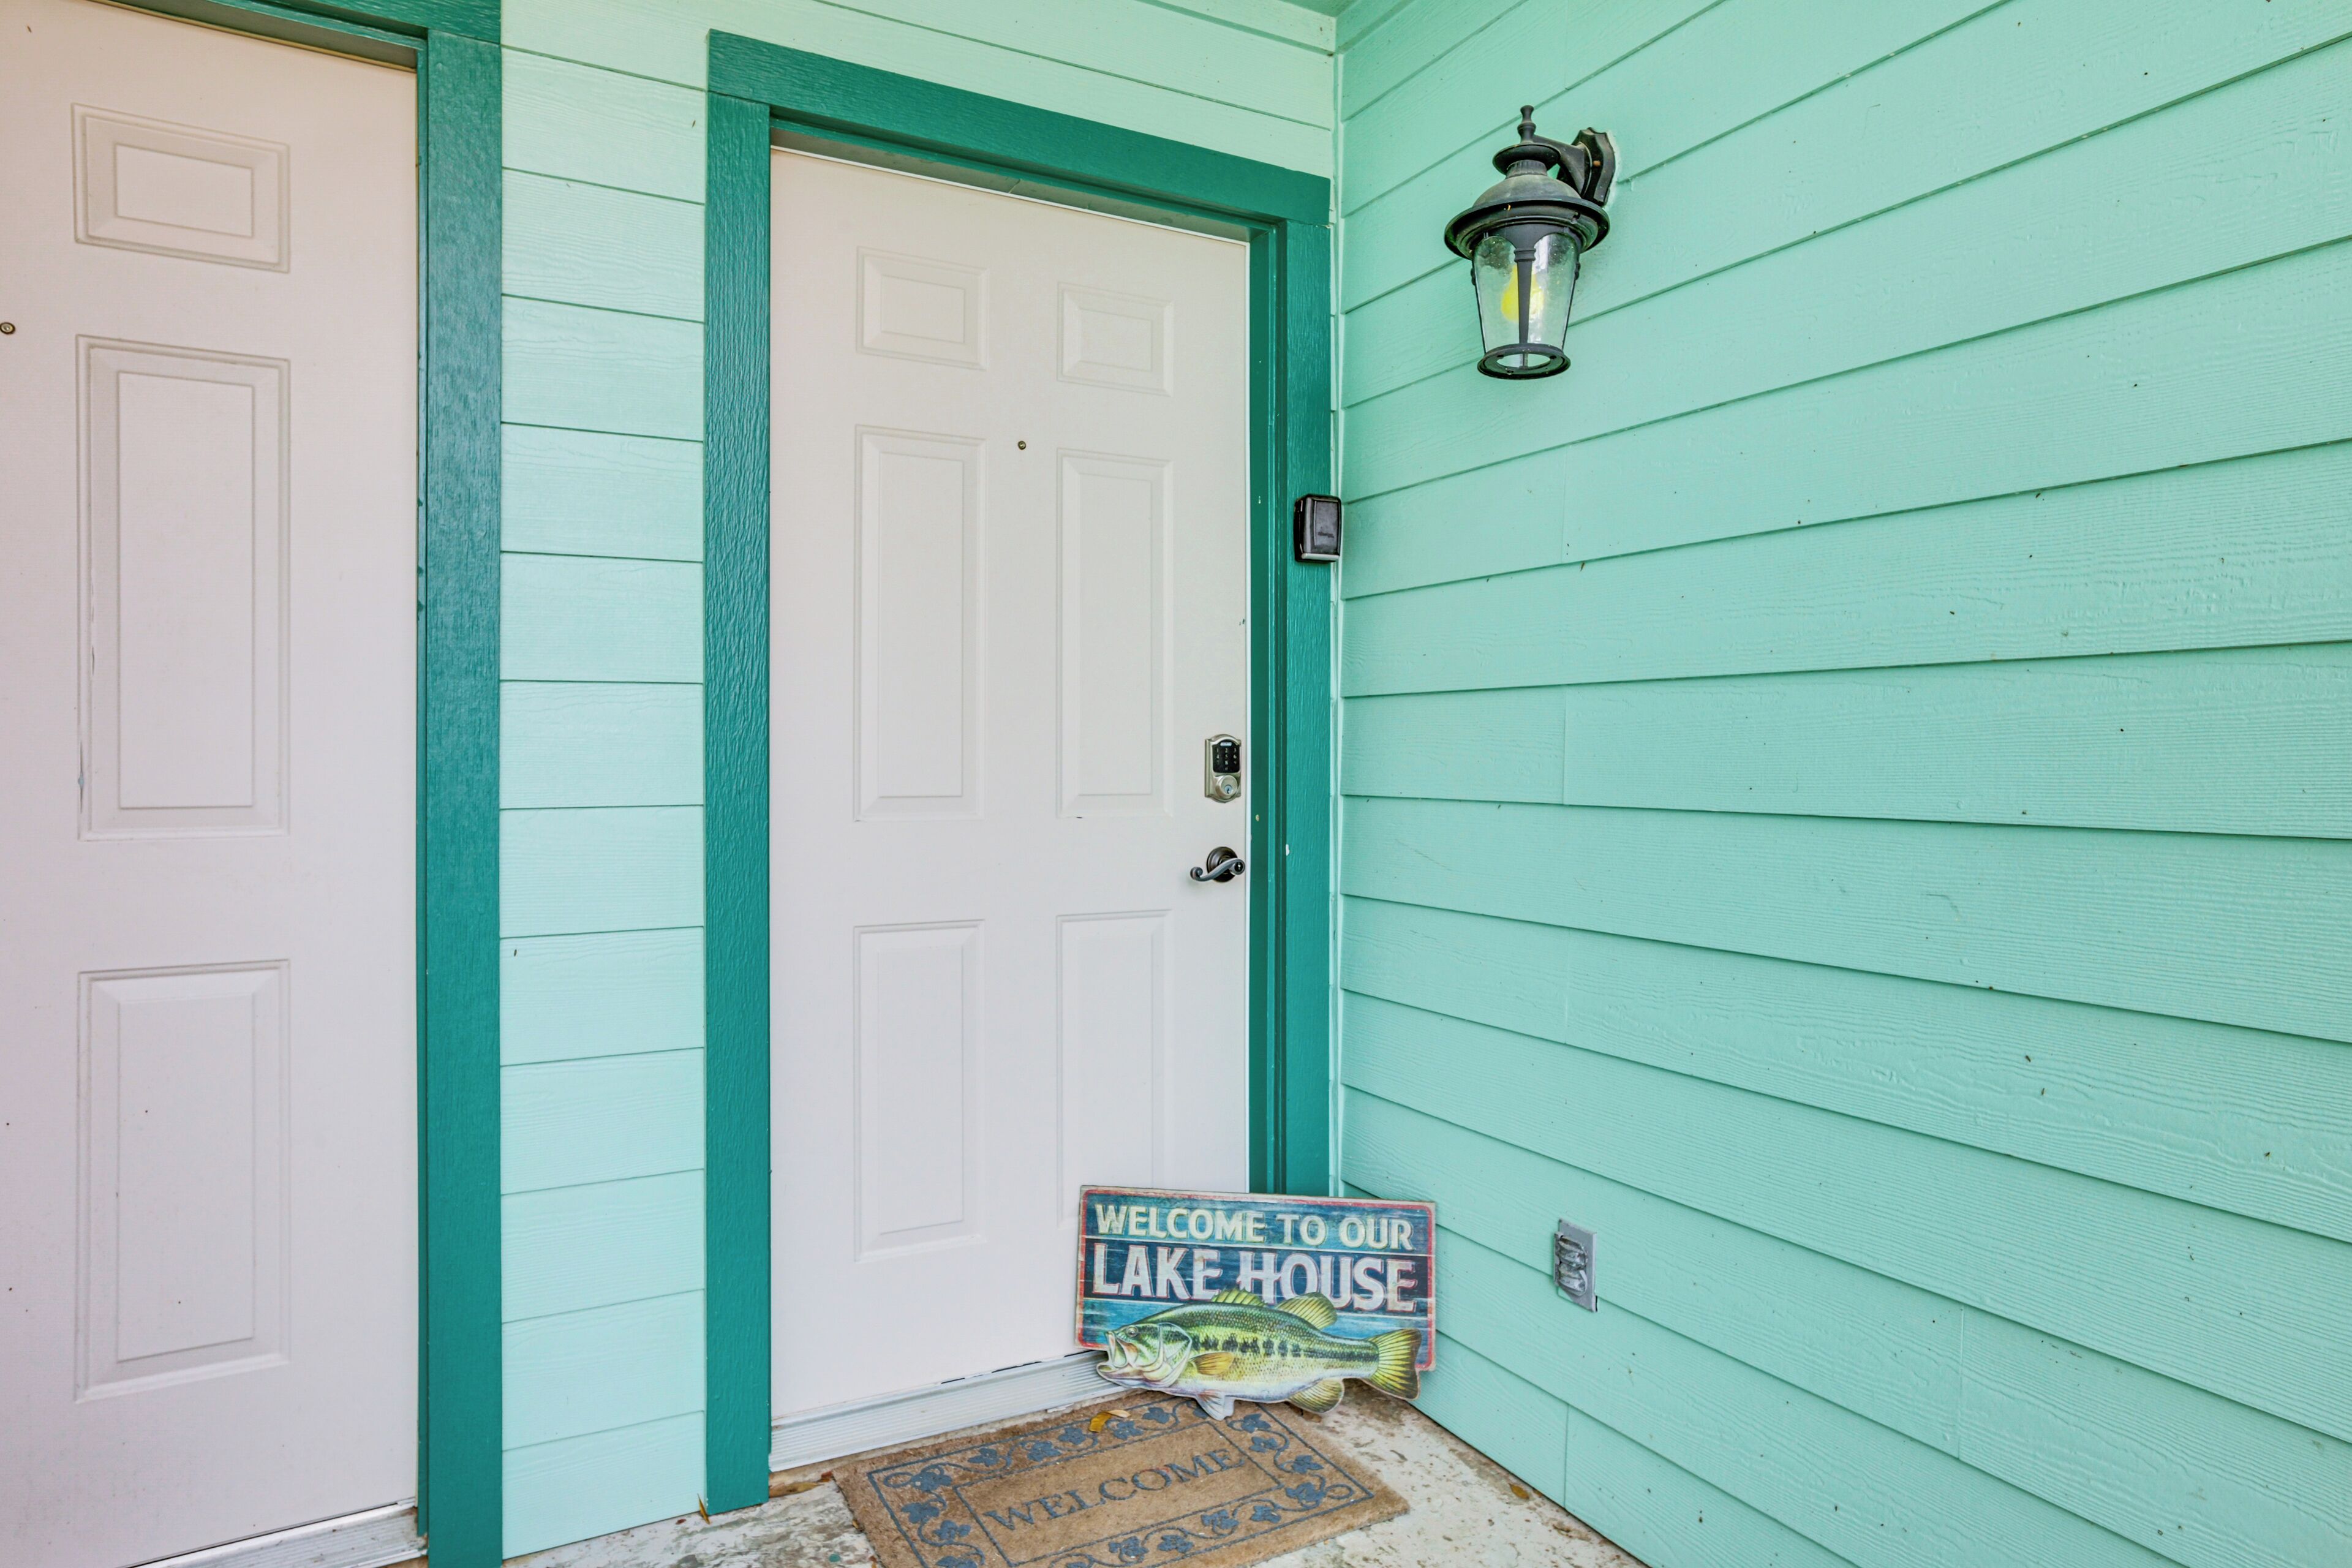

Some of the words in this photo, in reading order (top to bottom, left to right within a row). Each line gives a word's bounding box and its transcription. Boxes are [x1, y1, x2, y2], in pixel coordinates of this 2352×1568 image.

[1095, 1204, 1267, 1243] WELCOME
[1276, 1214, 1328, 1246] TO
[1339, 1216, 1415, 1251] OUR
[1093, 1243, 1223, 1301] LAKE
[1236, 1251, 1418, 1313] HOUSE
[982, 1448, 1246, 1530] WELCOME
